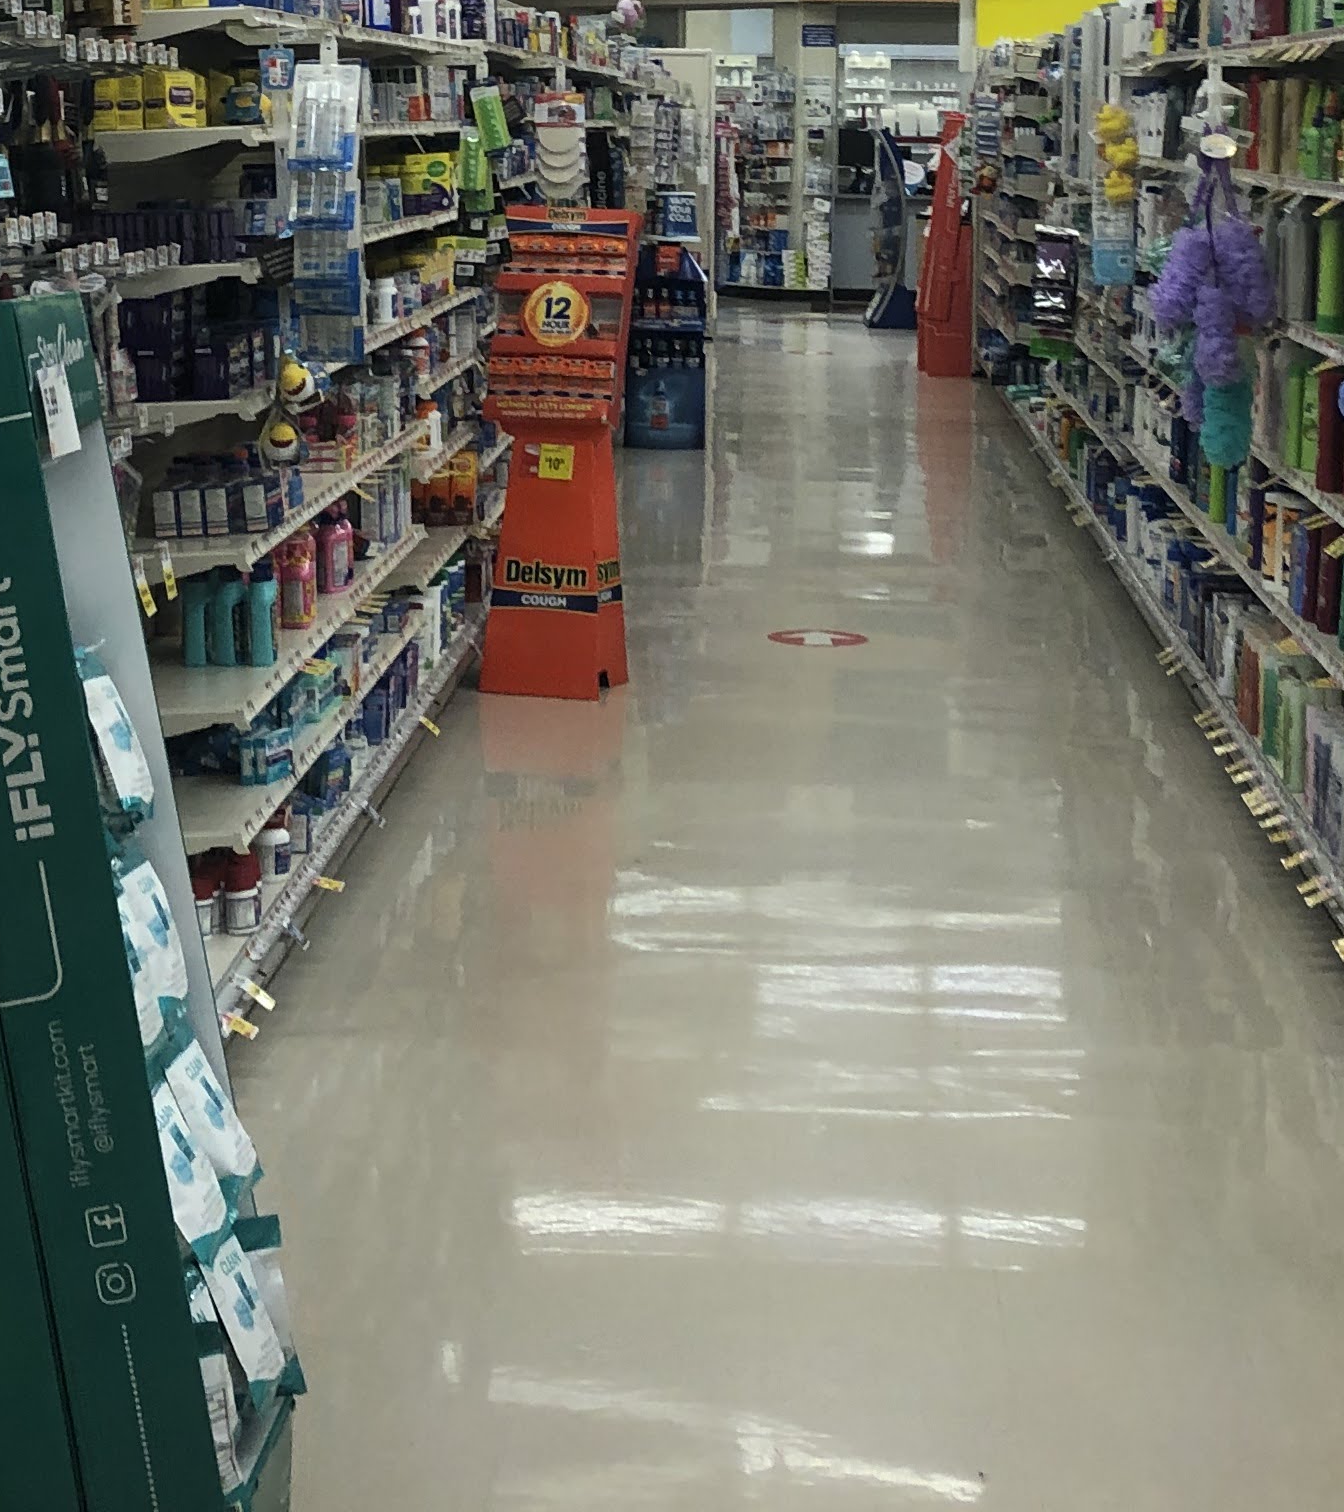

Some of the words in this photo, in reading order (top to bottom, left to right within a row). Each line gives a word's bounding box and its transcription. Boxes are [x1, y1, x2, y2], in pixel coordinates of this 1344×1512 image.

[544, 297, 573, 320] 12
[542, 320, 570, 329] HOUR
[506, 559, 587, 589] Delsym
[520, 594, 567, 607] COUGH
